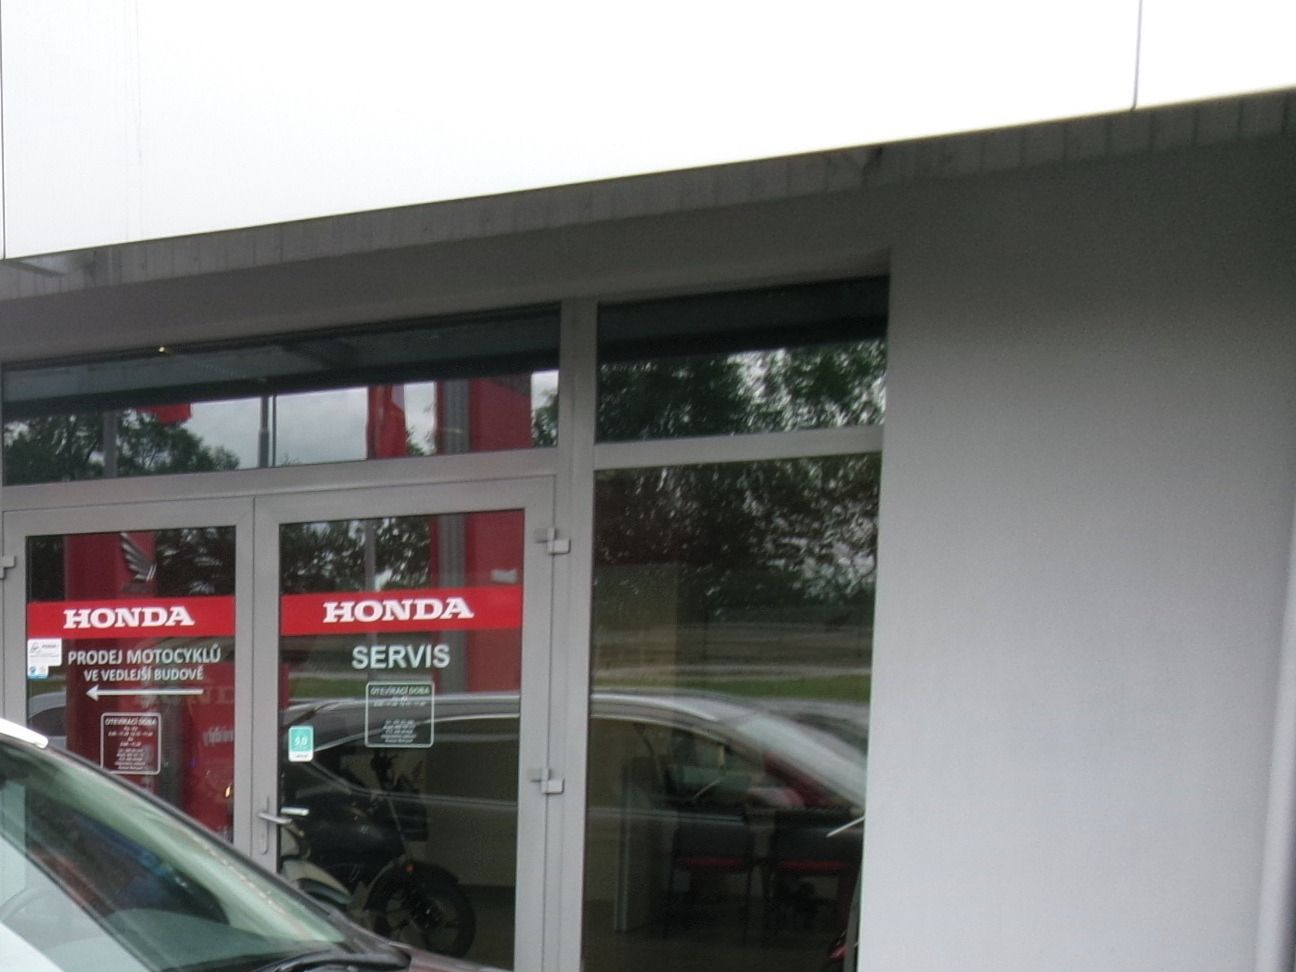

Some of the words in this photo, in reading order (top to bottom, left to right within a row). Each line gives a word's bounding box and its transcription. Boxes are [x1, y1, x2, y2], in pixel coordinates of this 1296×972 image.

[63, 606, 195, 629] HONDA
[323, 597, 474, 623] HONDA
[67, 651, 122, 666] PRODEJ
[128, 645, 221, 664] MOTOCYKLŮ
[351, 644, 451, 670] SERVIS
[83, 669, 99, 682] VE
